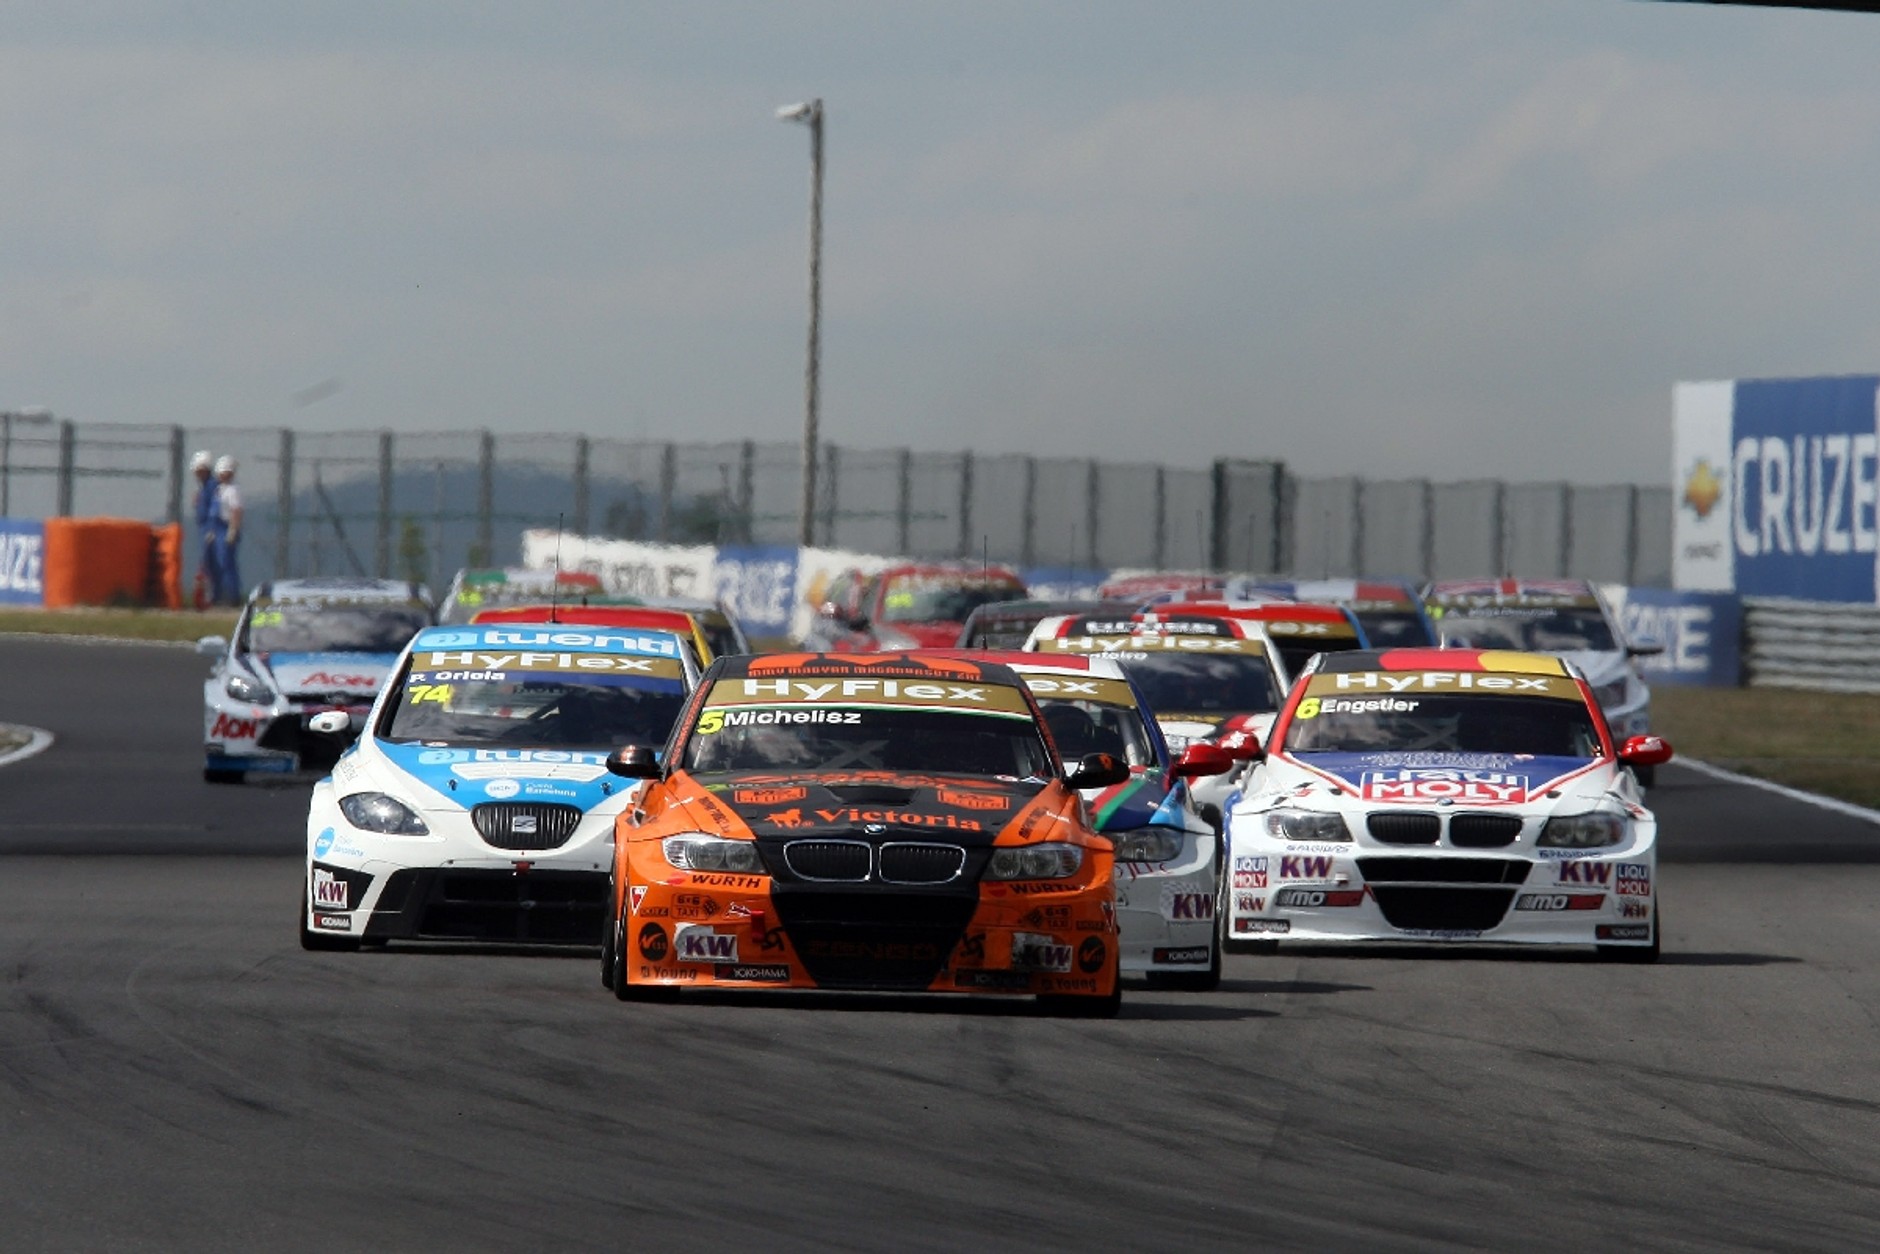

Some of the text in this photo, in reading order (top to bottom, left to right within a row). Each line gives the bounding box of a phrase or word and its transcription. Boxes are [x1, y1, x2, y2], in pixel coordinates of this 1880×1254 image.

[1733, 434, 1877, 557] CRUZE
[485, 630, 676, 655] tuenti
[1057, 636, 1241, 652] HyFlex
[430, 652, 653, 671] HyFlex
[743, 679, 987, 701] HyFlex
[1336, 673, 1549, 692] HyFlex
[408, 684, 450, 705] 74
[1296, 698, 1420, 719] 6 Engstler
[697, 710, 862, 735] 5 Michelisz
[1371, 783, 1526, 800] MOLY
[815, 808, 982, 831] Victoria
[1280, 856, 1334, 878] KW
[1558, 861, 1613, 884] KW
[692, 874, 762, 889] WÜRTH
[1235, 872, 1267, 888] MOLY
[1617, 880, 1649, 895] MOLY
[319, 881, 347, 902] KW
[676, 907, 700, 918] TAXI
[1173, 893, 1214, 919] KW
[686, 935, 736, 956] KW
[733, 968, 788, 979] YOKOHAMA
